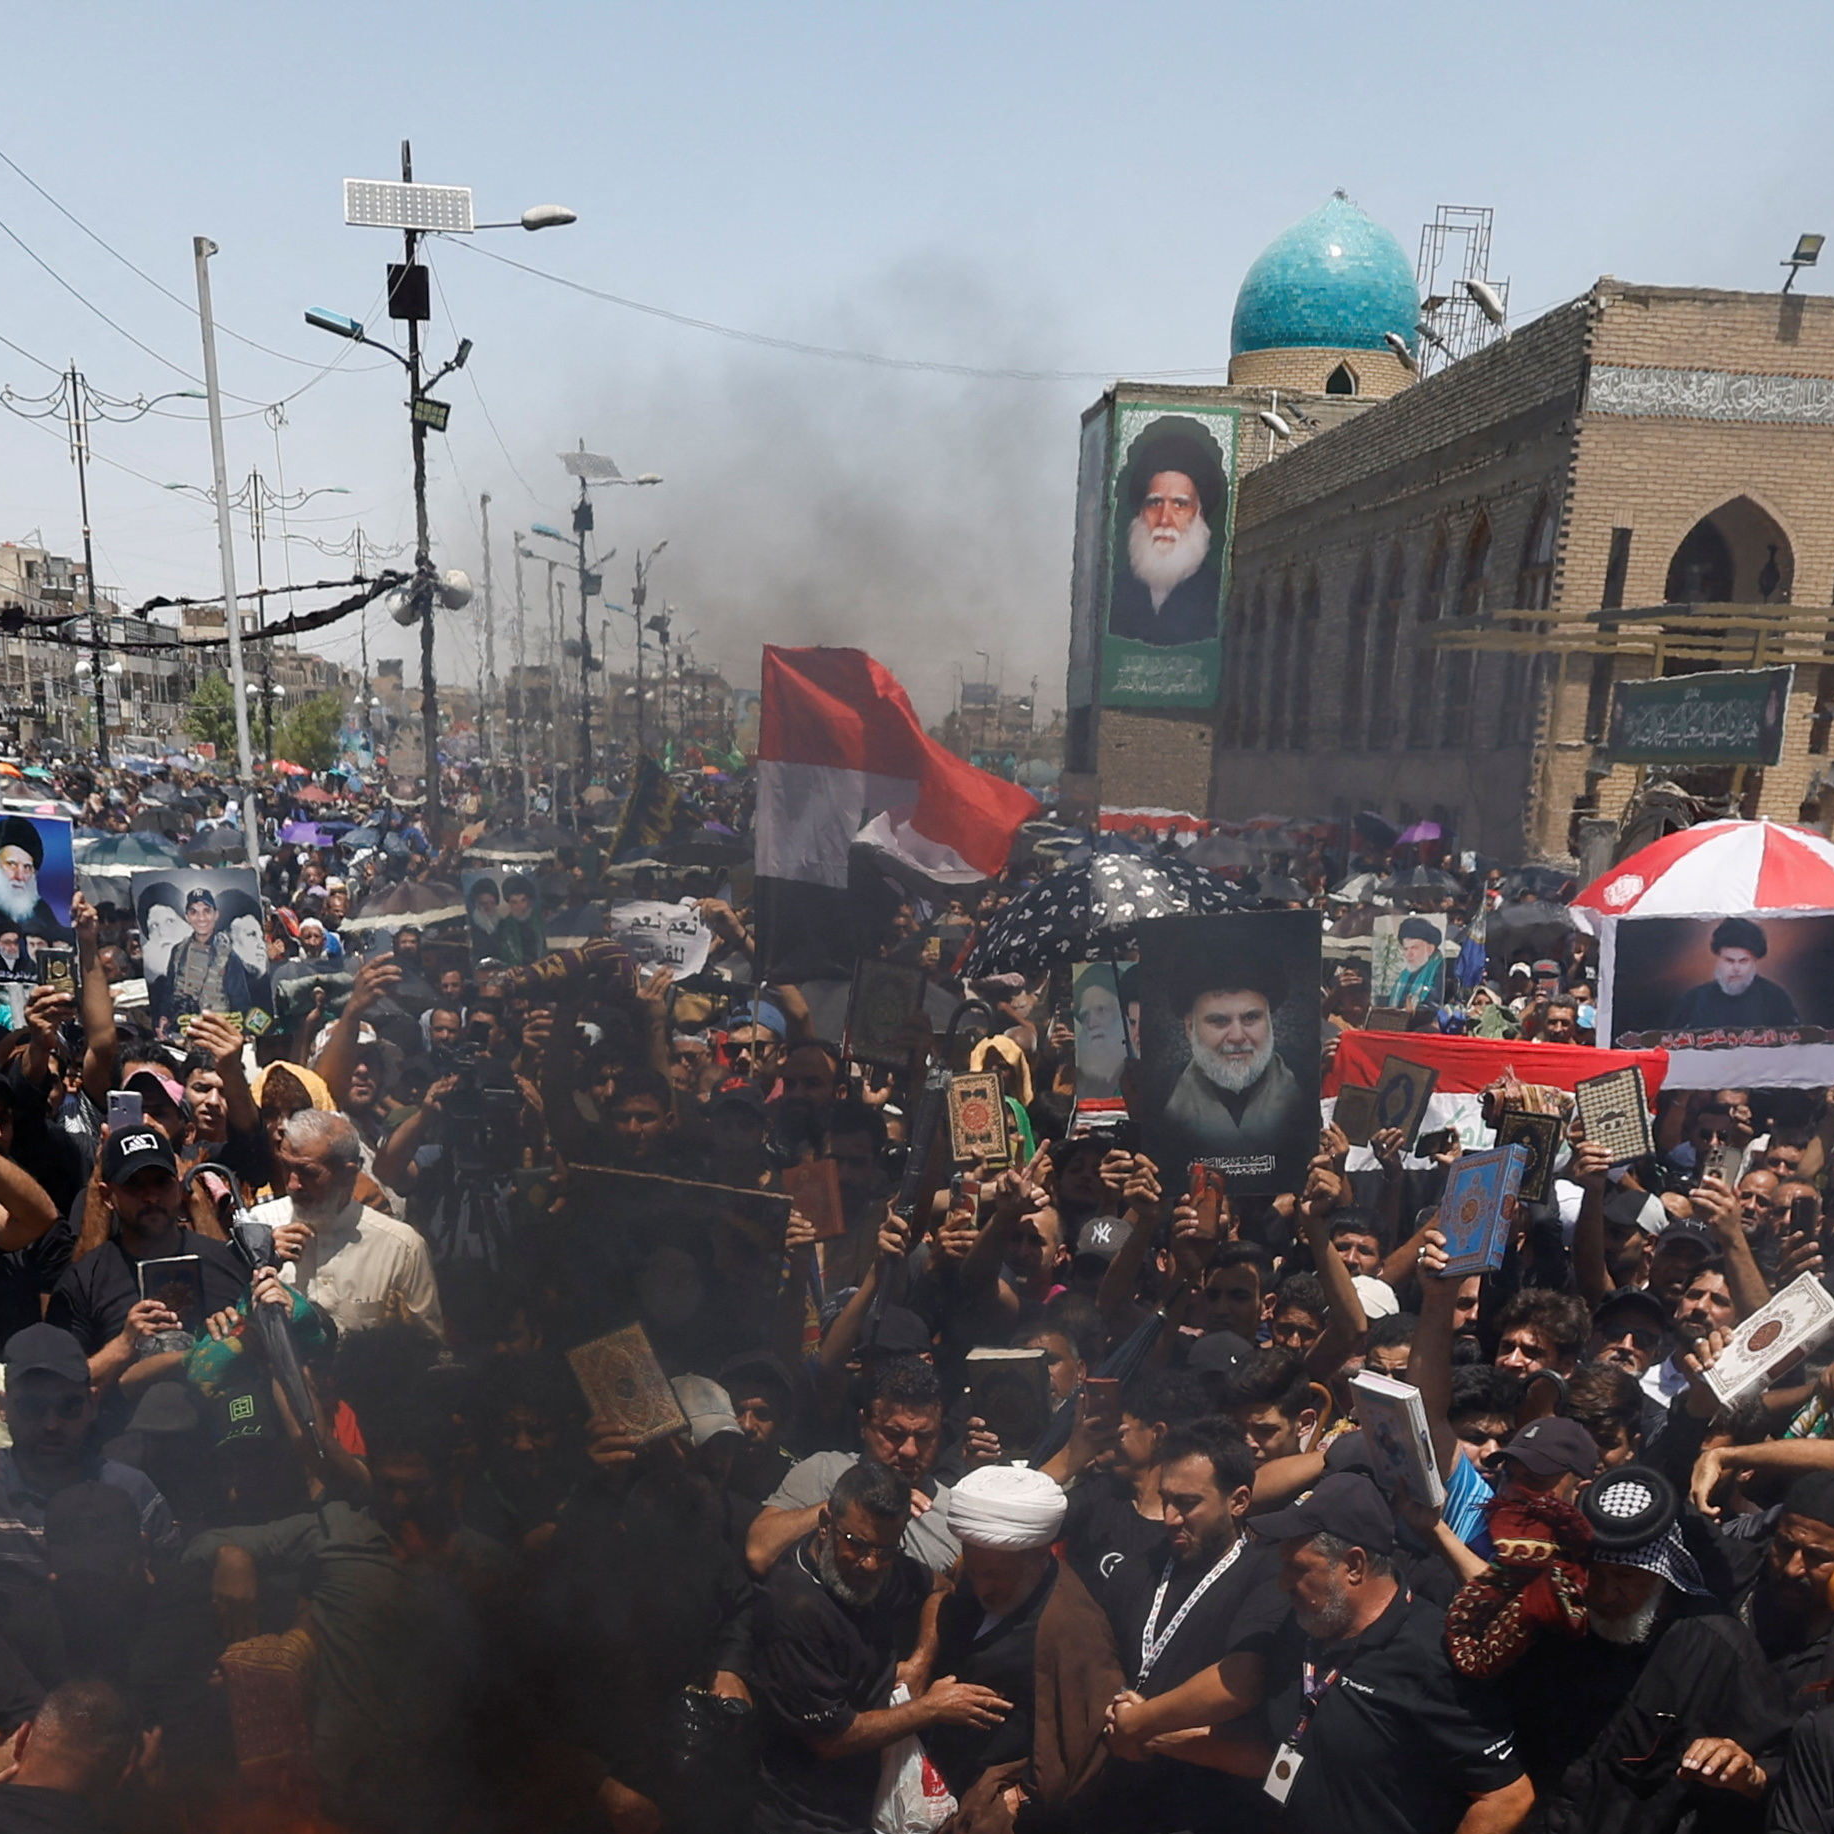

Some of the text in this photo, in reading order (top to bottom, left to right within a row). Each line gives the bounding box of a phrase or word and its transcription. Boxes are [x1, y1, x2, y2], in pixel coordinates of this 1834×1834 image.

[631, 911, 698, 942] نعم نعم
[1091, 1220, 1114, 1245] NY
